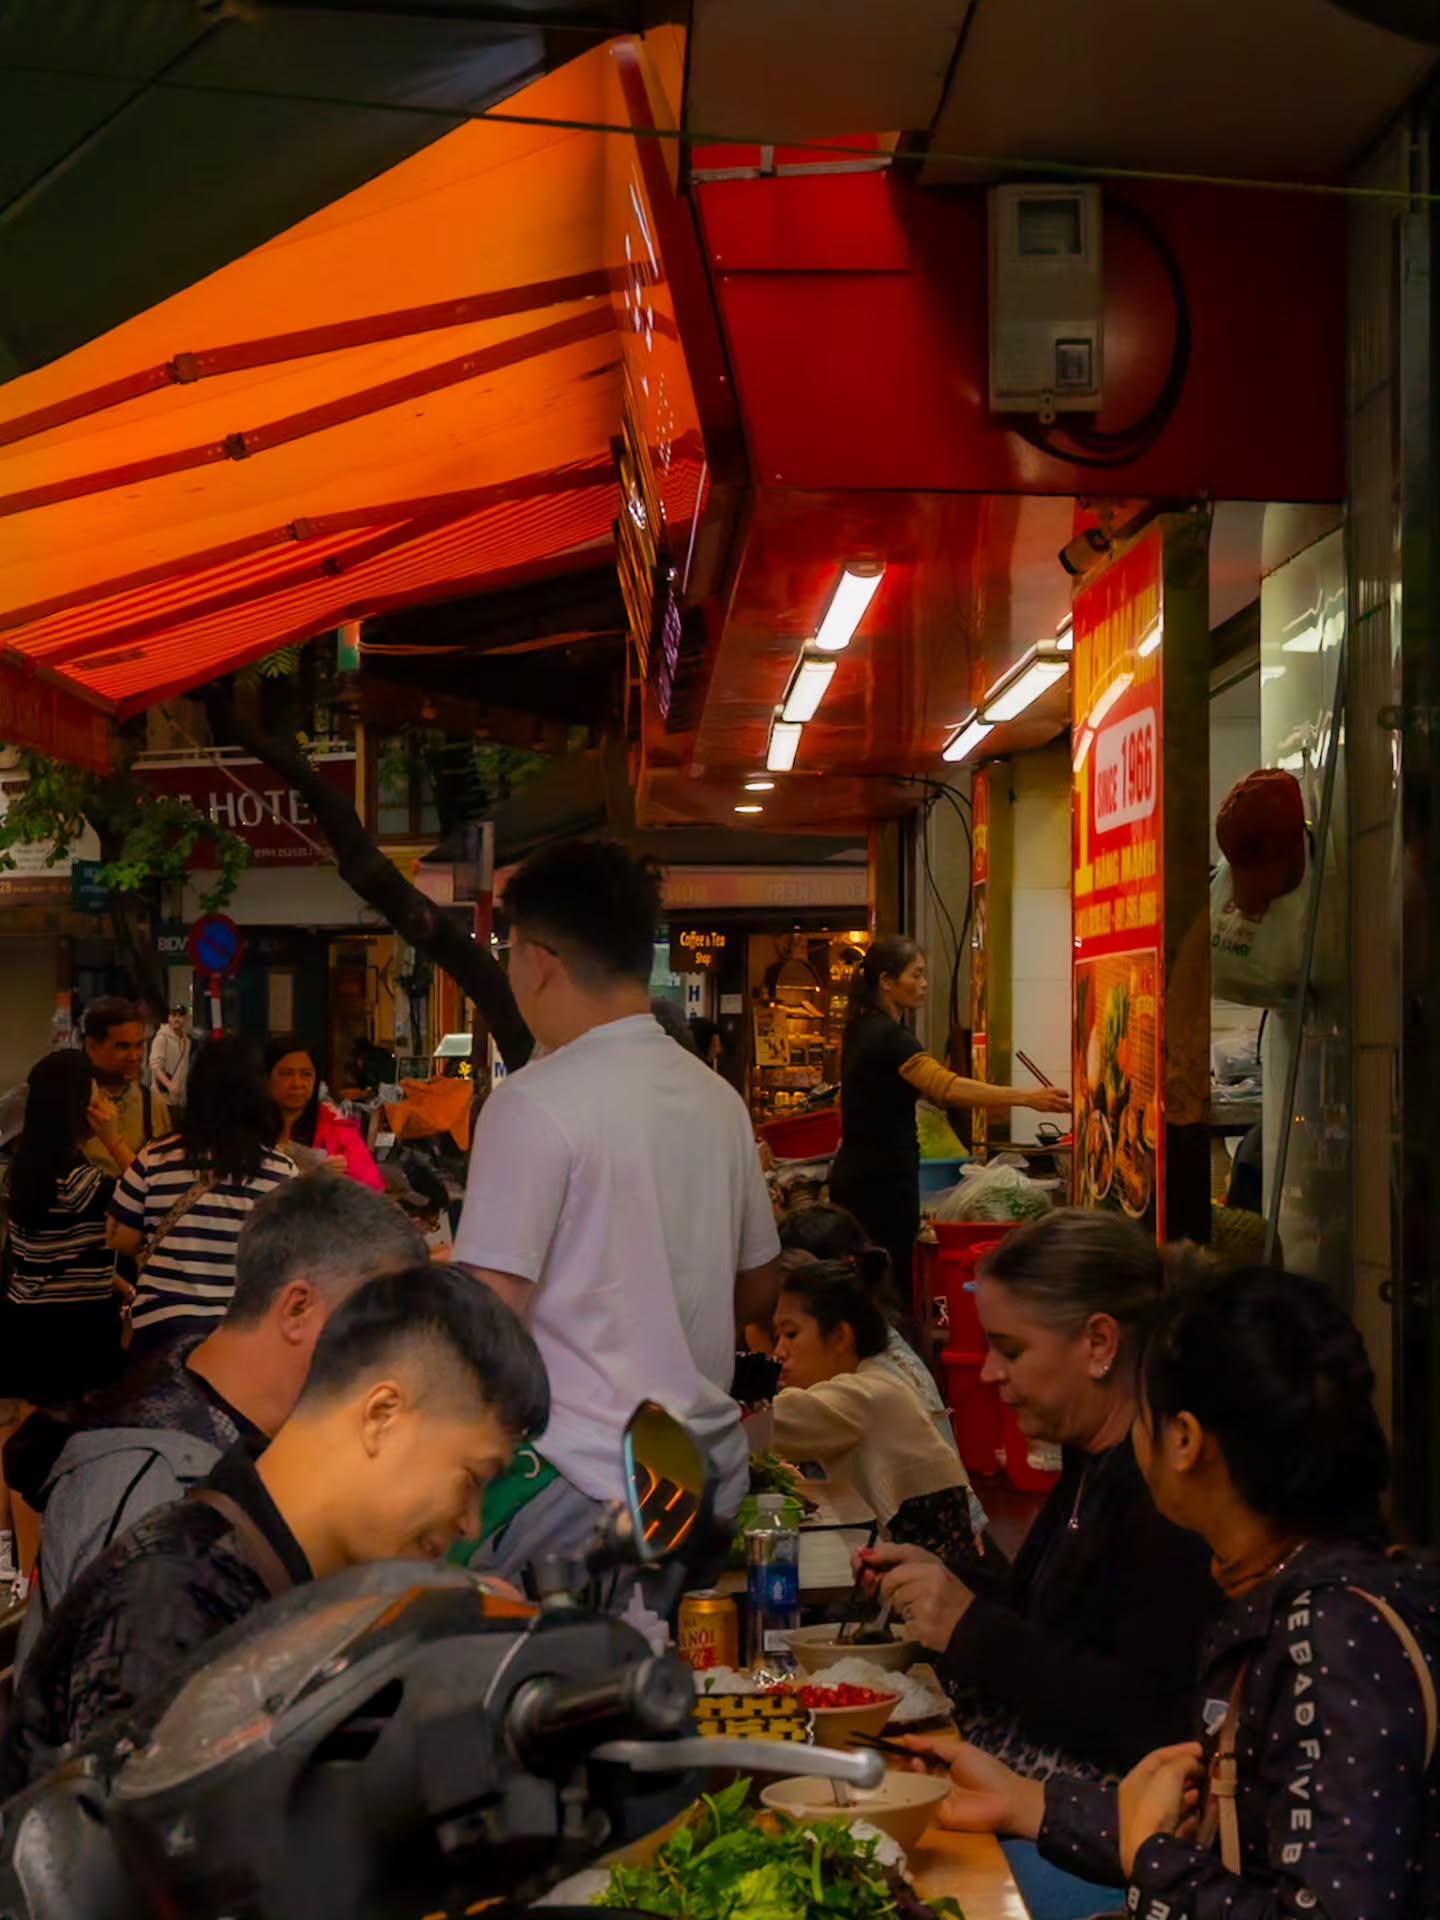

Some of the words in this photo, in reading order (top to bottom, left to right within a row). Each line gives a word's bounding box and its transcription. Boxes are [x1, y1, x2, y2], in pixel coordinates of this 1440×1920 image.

[1121, 723, 1153, 809] 1966
[208, 789, 317, 828] HOTE
[679, 930, 705, 950] Coffee
[711, 931, 727, 948] Tea
[695, 952, 712, 967] Shop
